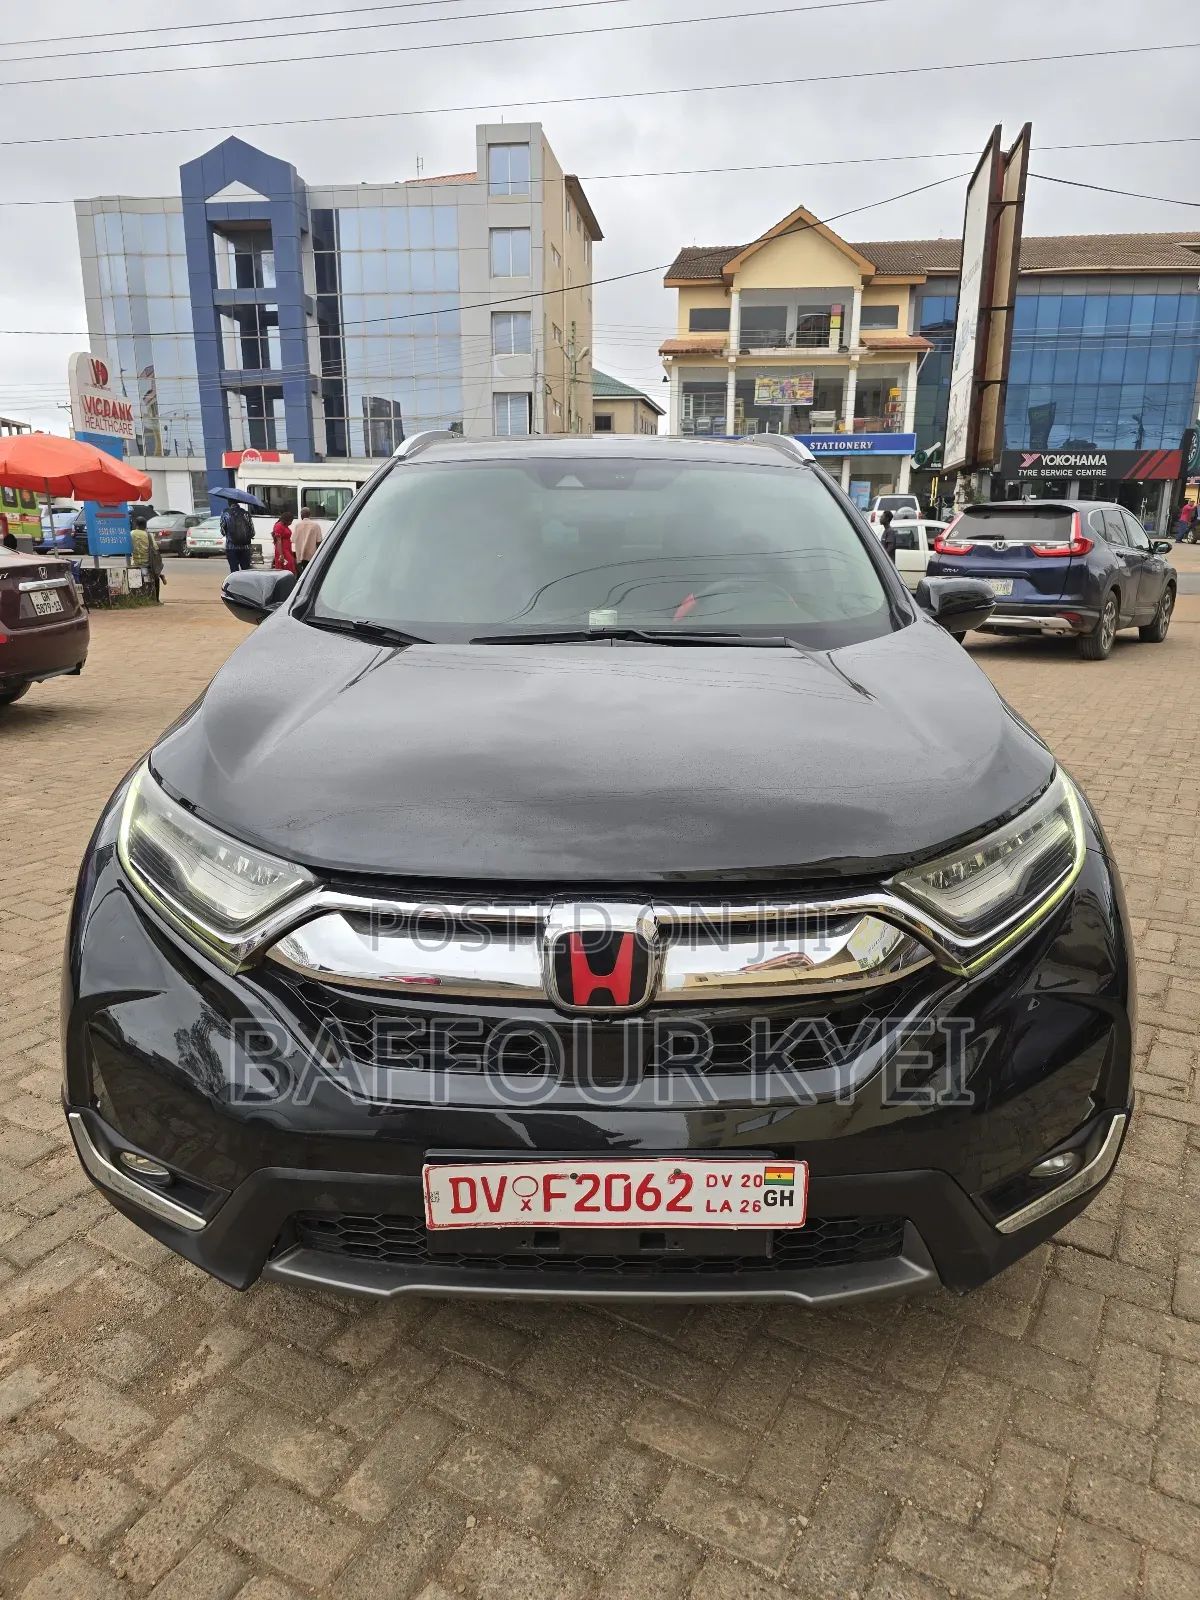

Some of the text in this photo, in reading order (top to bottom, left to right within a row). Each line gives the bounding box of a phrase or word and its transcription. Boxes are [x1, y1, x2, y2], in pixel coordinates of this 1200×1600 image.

[84, 395, 133, 421] VICDANK
[85, 415, 133, 435] HEALTHCARE
[810, 441, 873, 450] STATIONERY
[1040, 454, 1107, 466] YOKOHAMA
[706, 1174, 763, 1187] DV 20
[449, 1176, 507, 1214] DV
[542, 1172, 693, 1213] F2062
[763, 1189, 794, 1206] GH
[706, 1200, 761, 1212] LA 26
